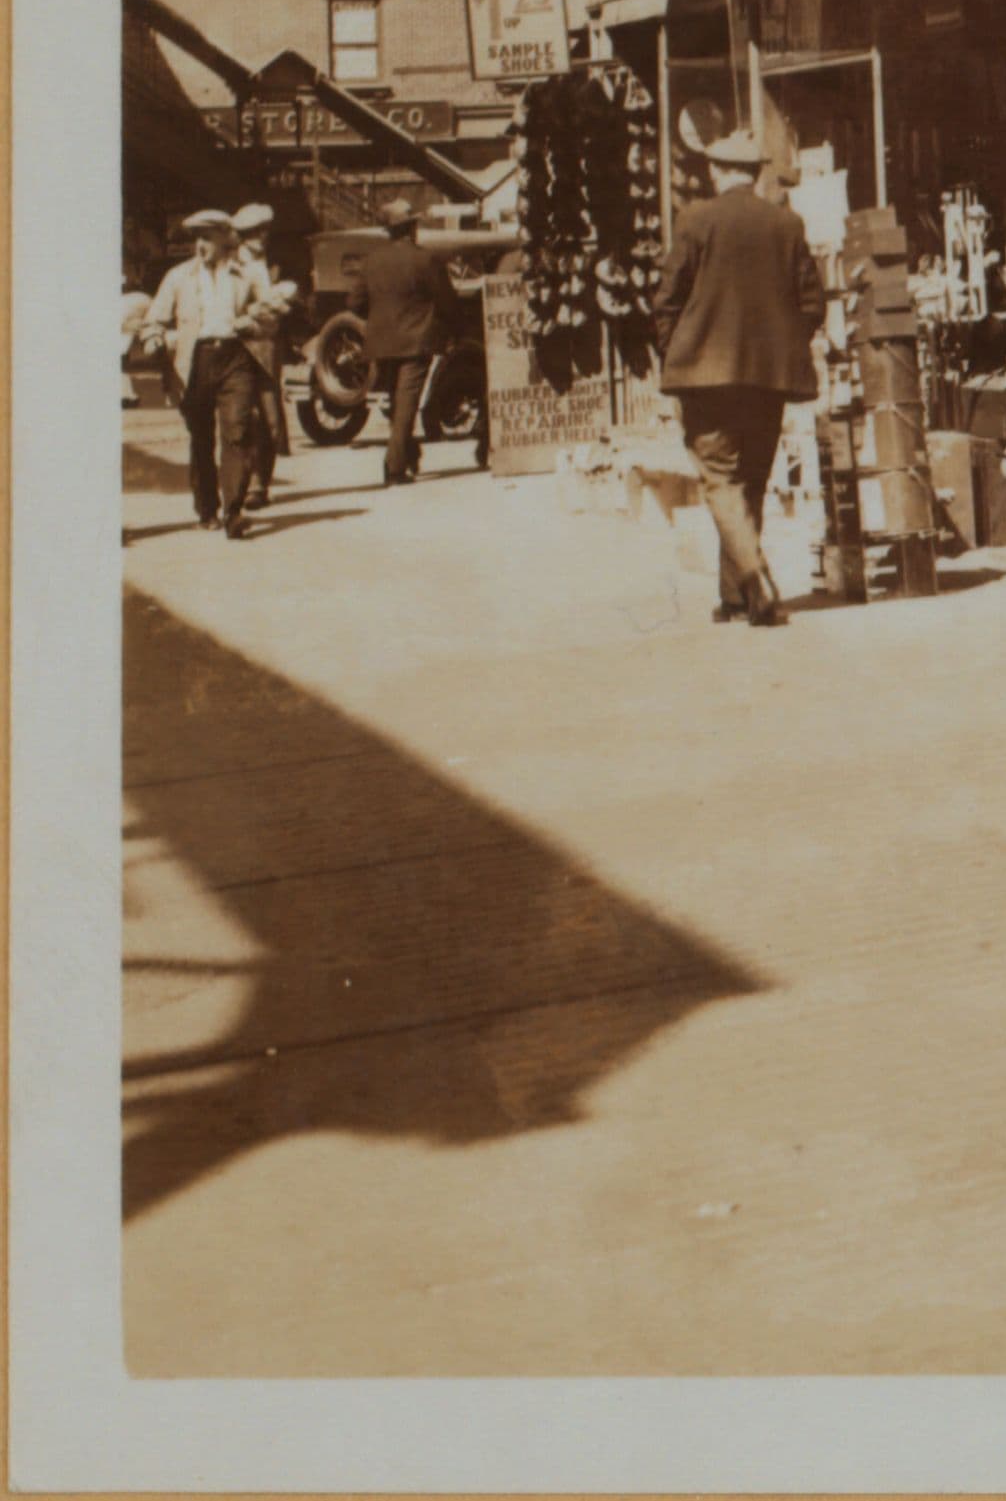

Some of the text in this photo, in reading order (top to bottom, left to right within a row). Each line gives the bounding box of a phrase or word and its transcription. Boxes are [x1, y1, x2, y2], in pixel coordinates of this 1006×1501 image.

[488, 41, 553, 59] SAMPLE
[501, 56, 555, 73] SHOES
[386, 107, 433, 131] CO.
[501, 411, 594, 431] REPAIRING
